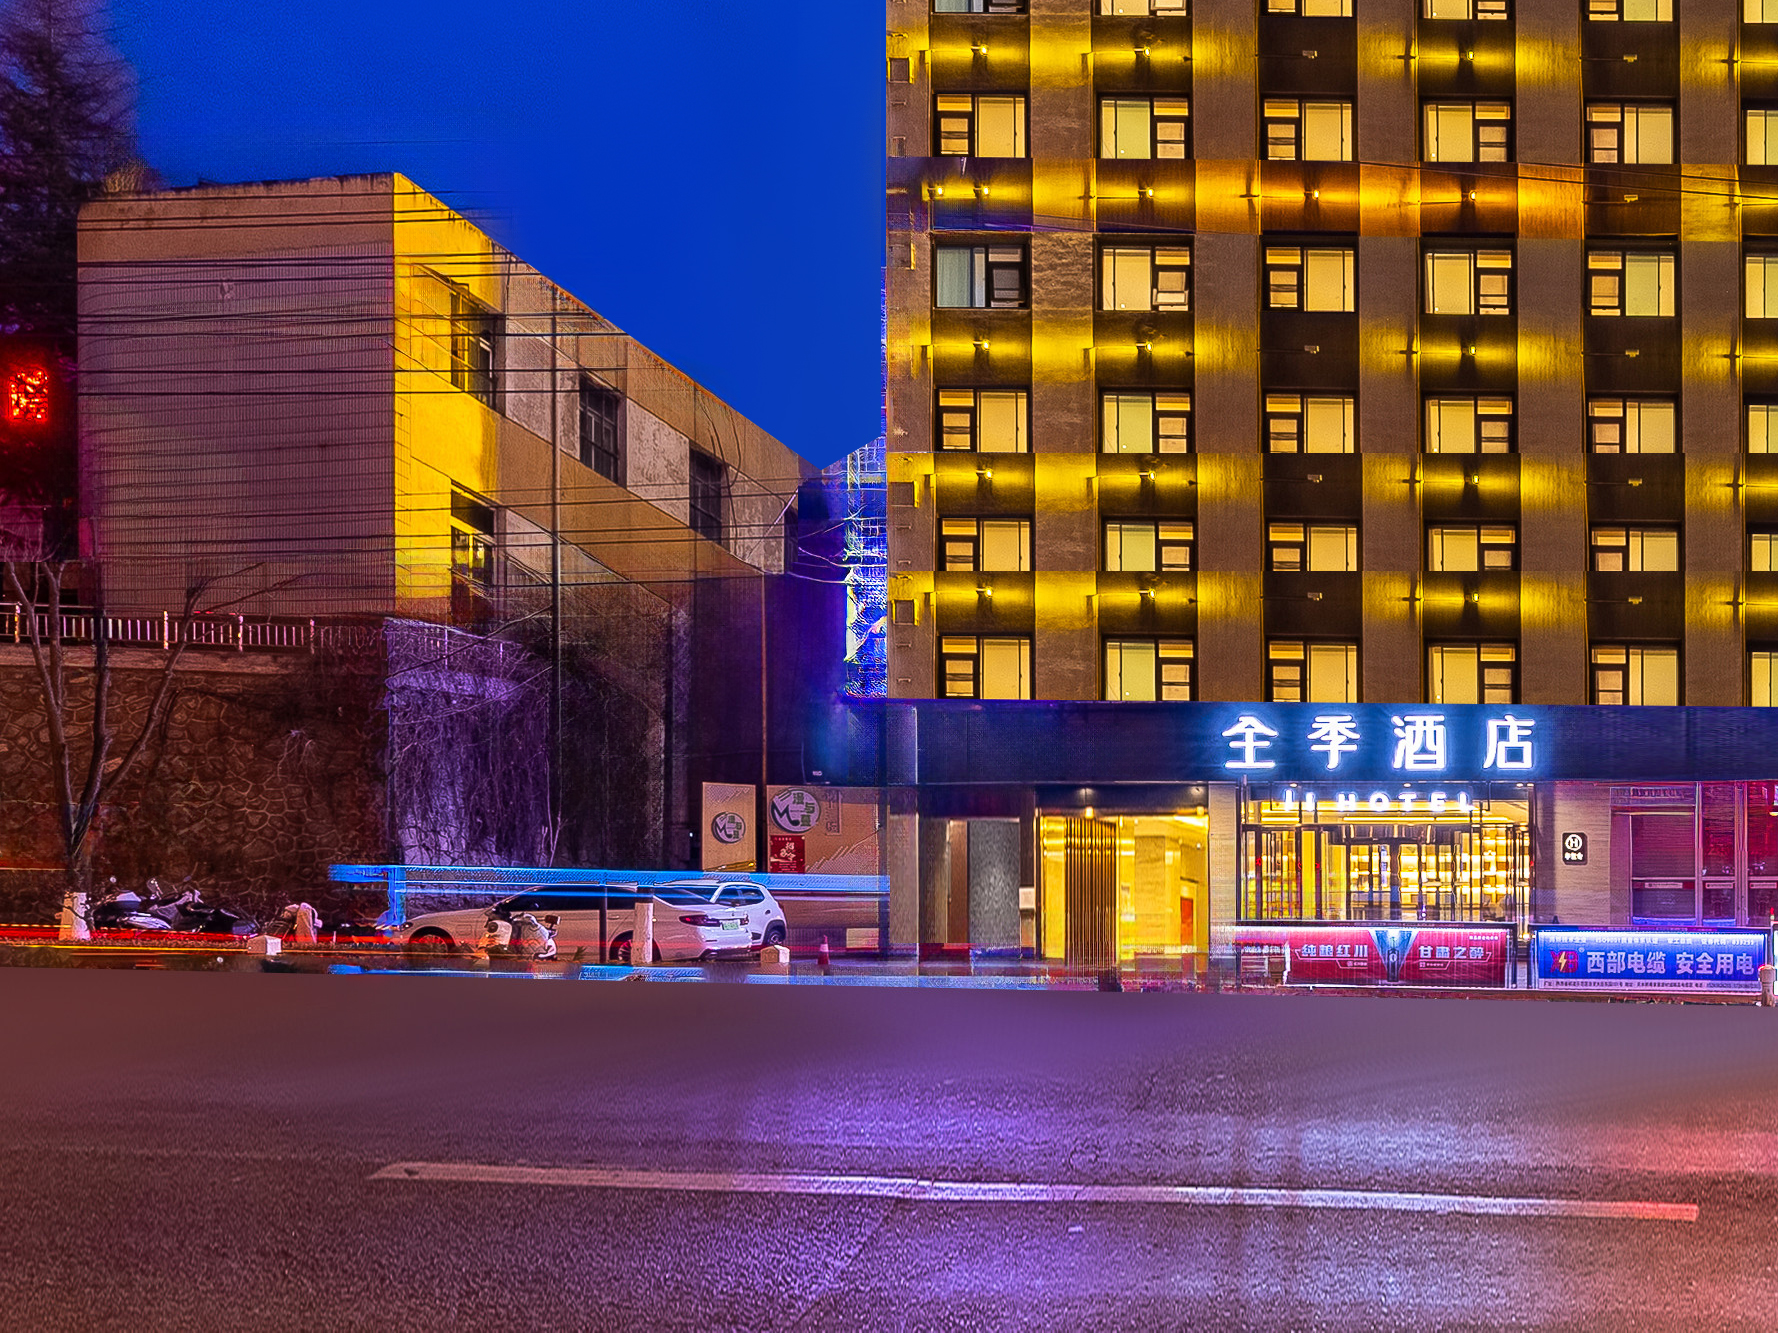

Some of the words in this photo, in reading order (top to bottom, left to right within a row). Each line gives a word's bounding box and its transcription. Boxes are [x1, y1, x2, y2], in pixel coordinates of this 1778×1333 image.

[1221, 714, 1536, 770] 全季酒店
[1337, 791, 1474, 812] HOTEL
[1586, 951, 1667, 974] 西部电缆
[1676, 952, 1755, 975] 安全用电
